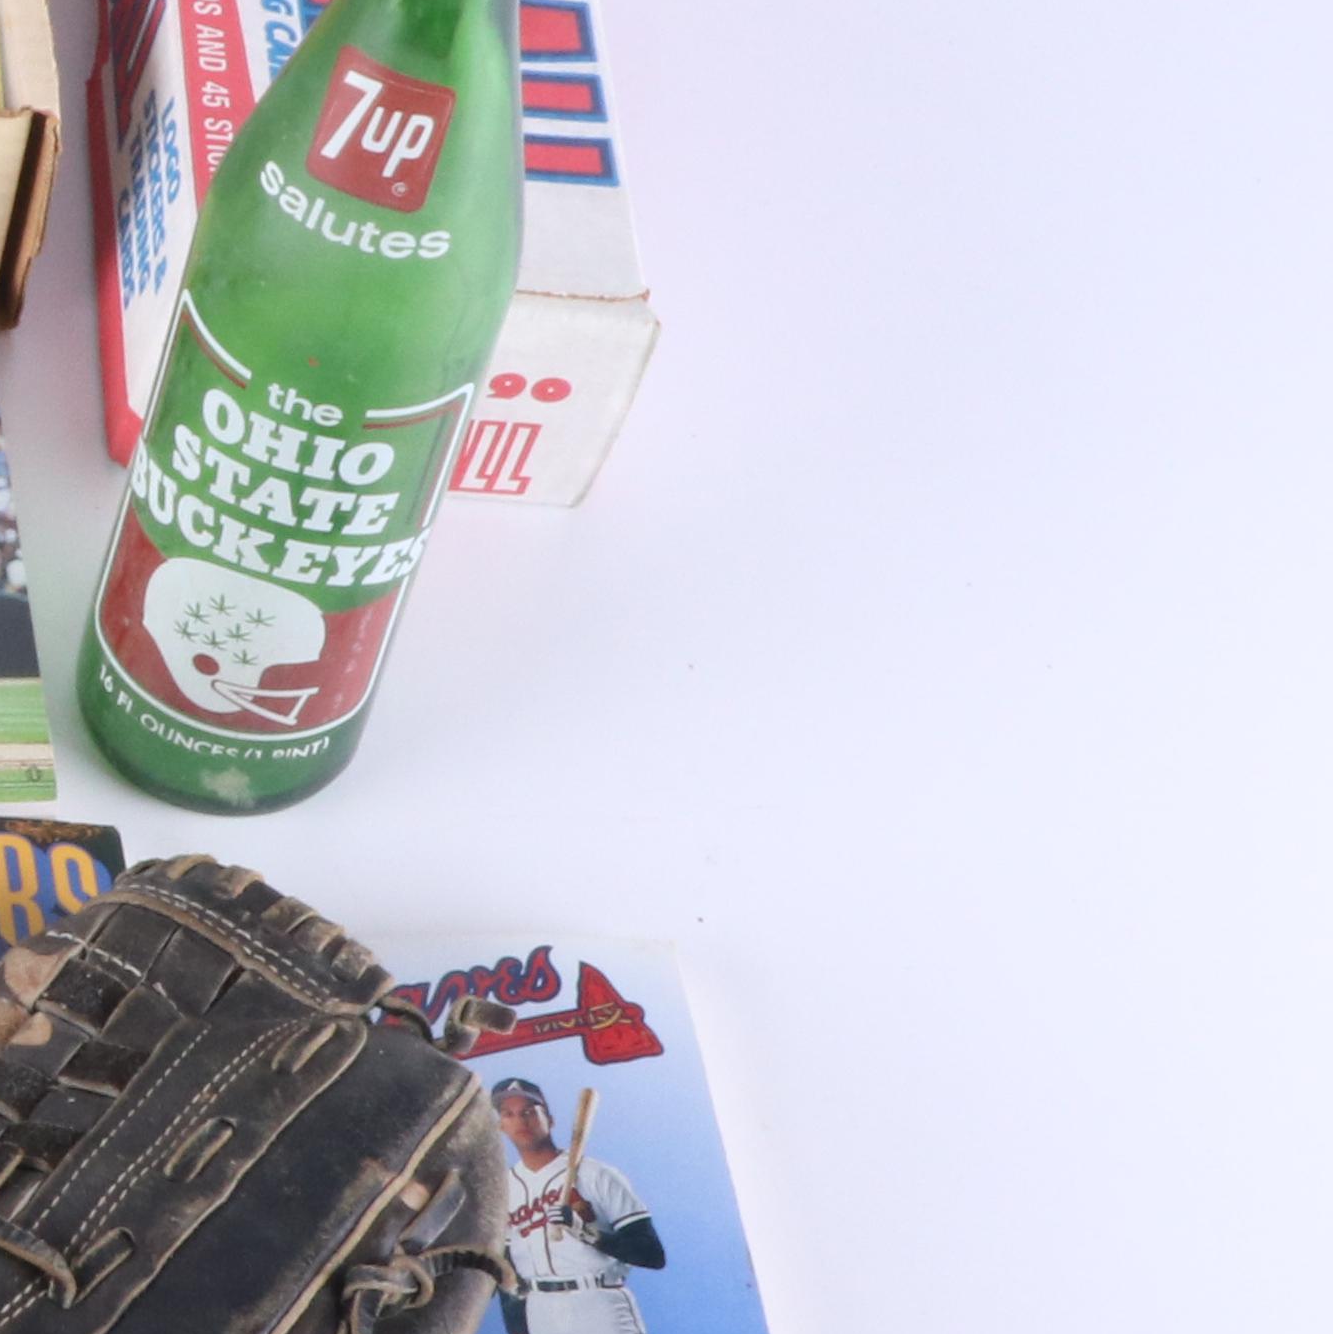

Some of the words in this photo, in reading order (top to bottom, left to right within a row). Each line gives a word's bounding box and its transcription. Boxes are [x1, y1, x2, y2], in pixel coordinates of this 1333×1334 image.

[196, 23, 228, 72] AND
[201, 81, 231, 108] 45
[162, 96, 181, 204] LOGO
[260, 160, 452, 259] salutes
[202, 388, 395, 486] OHIO
[268, 382, 344, 427] the
[130, 437, 431, 588] BUCKEYES
[173, 423, 400, 536] STATE
[140, 713, 240, 758] OUNCES
